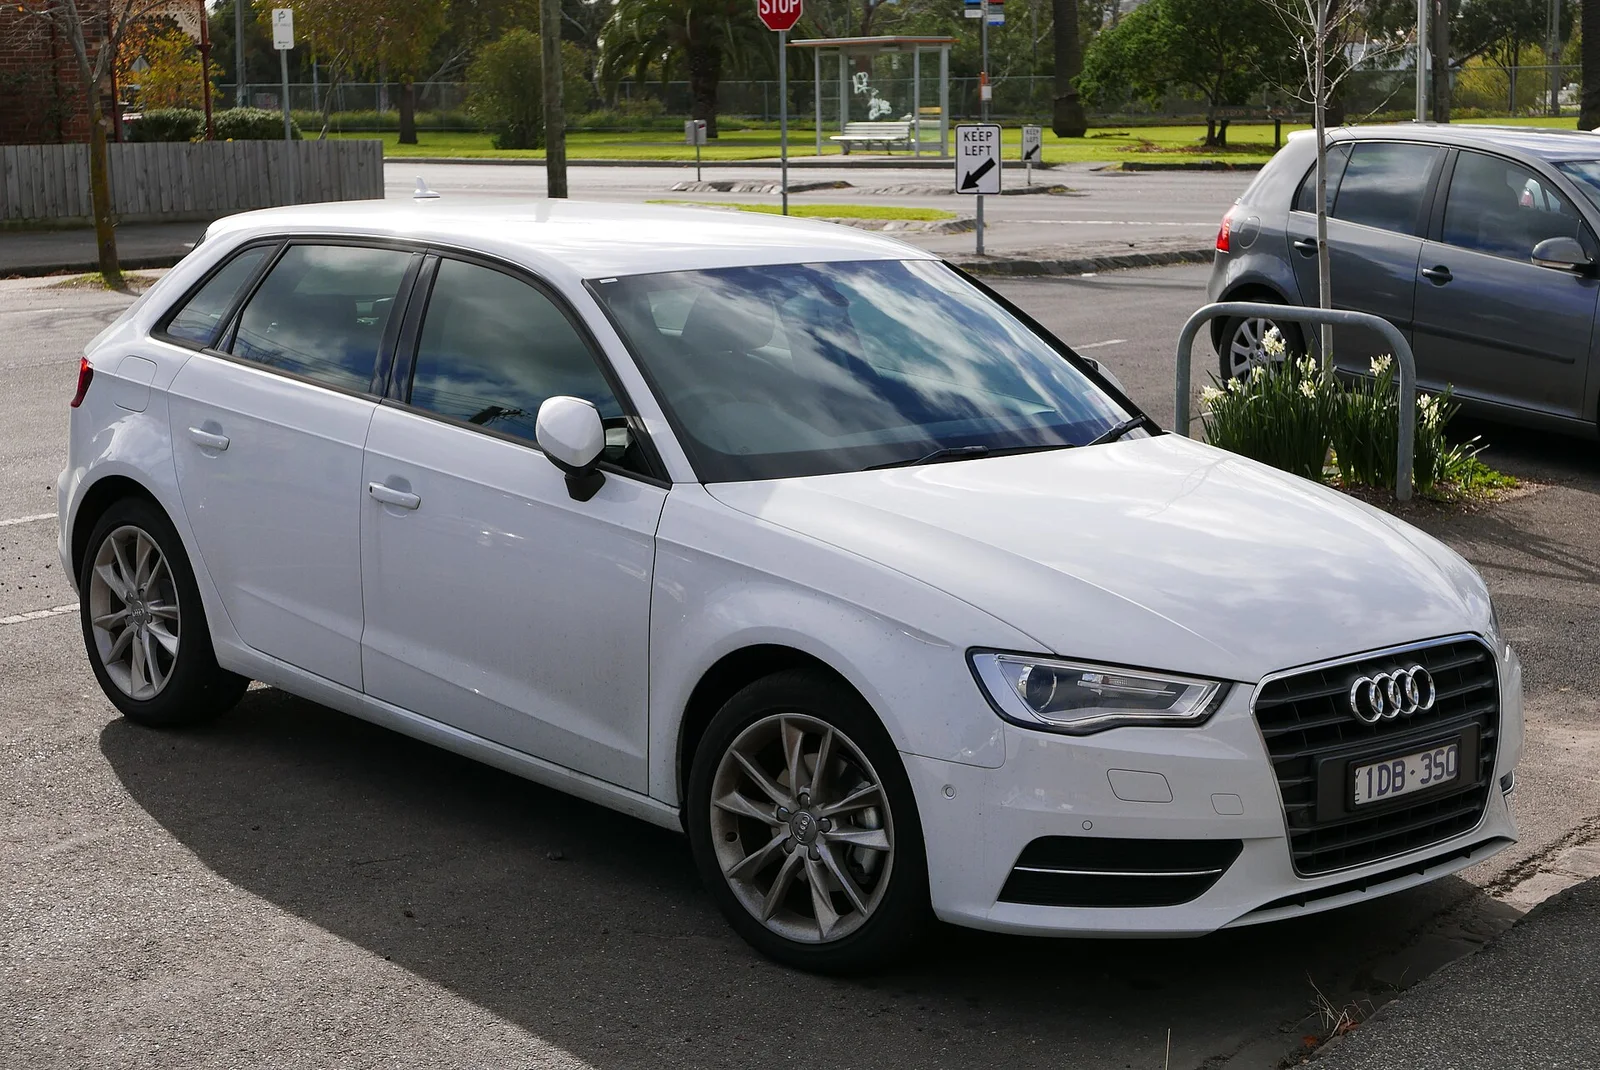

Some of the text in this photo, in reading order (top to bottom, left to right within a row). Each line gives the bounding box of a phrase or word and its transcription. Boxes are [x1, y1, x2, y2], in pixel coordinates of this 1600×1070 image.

[761, 0, 799, 14] STOP
[964, 131, 993, 142] KEEP
[965, 145, 992, 156] LEFT
